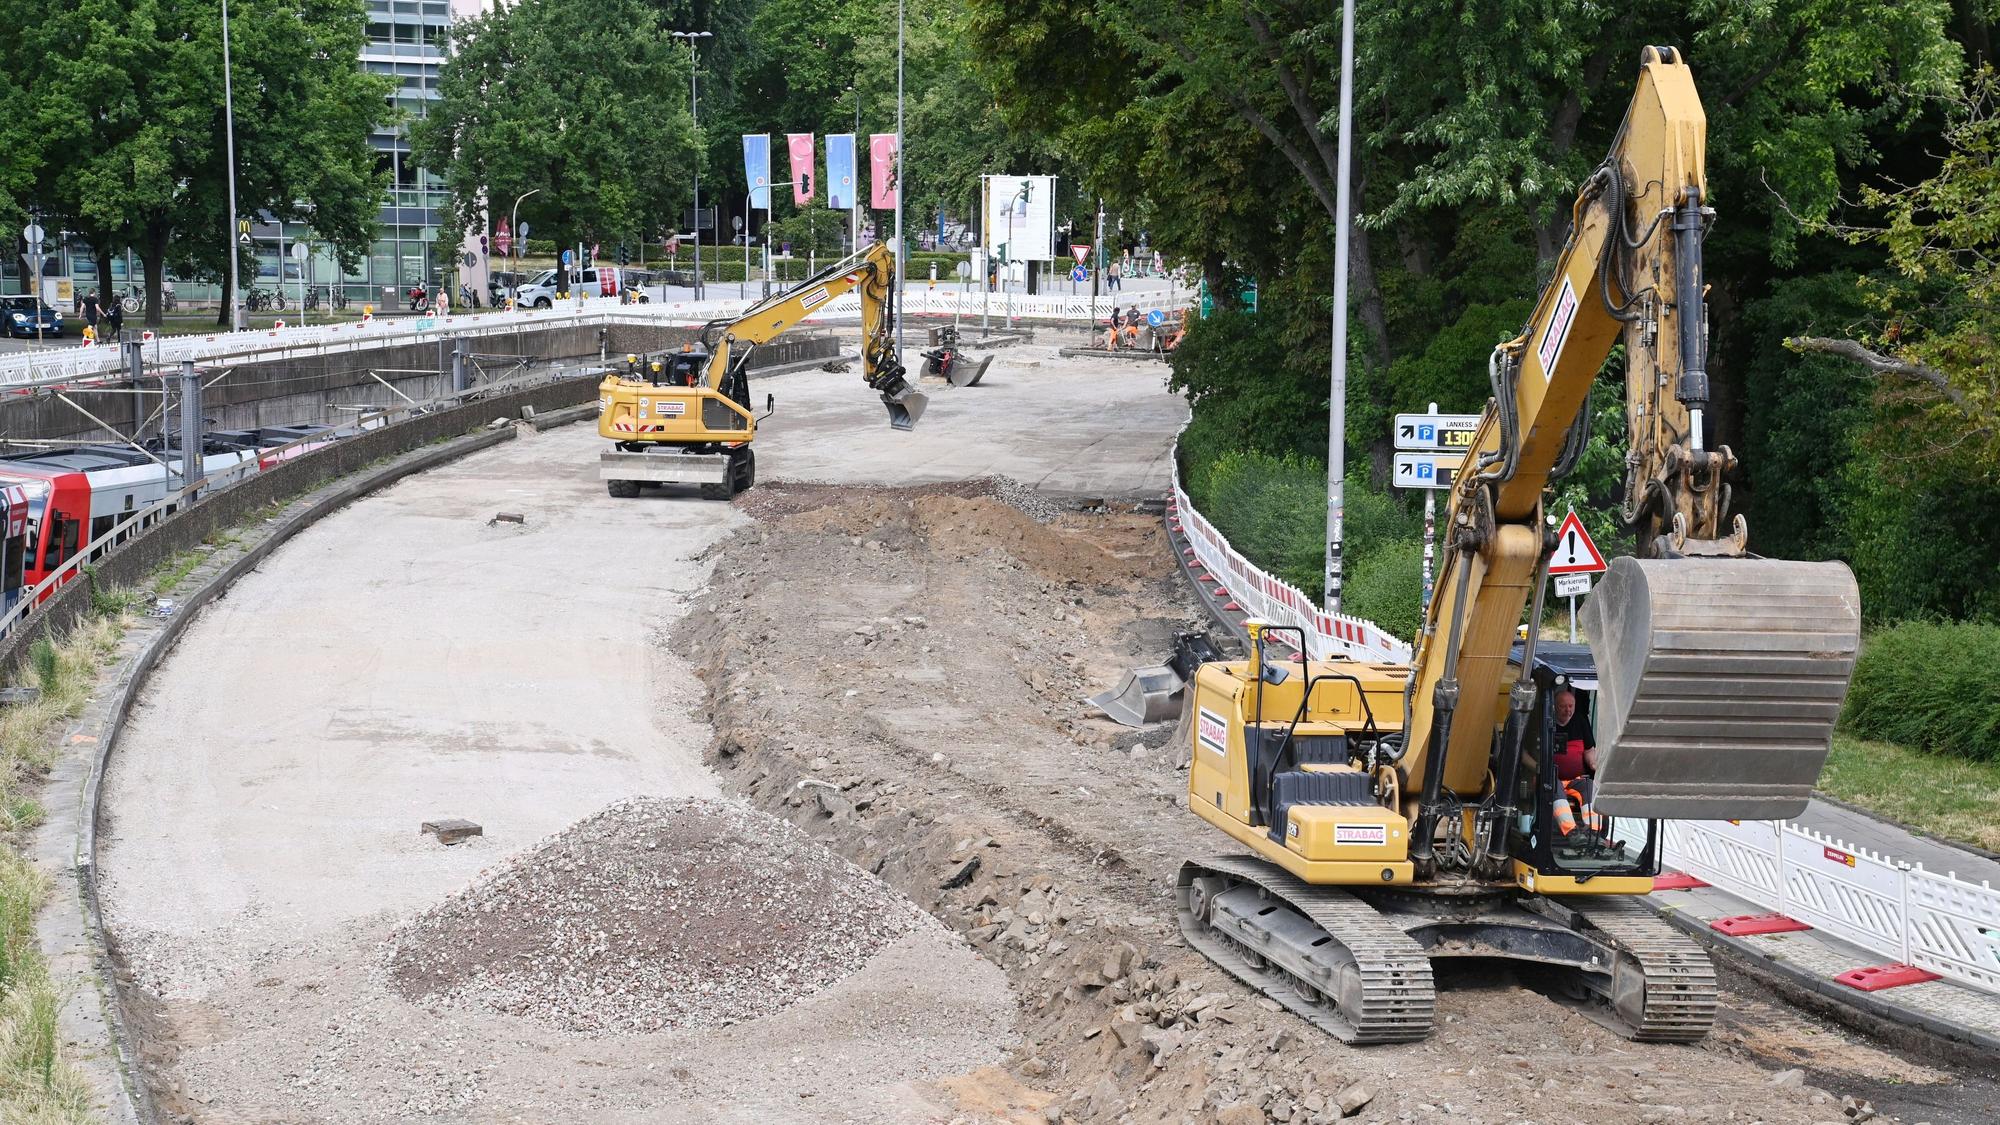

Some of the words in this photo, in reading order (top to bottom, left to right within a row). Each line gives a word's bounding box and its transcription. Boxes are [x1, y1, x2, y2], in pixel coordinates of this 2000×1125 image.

[803, 291, 827, 305] STRABAG
[1542, 290, 1573, 368] STRABAG
[1200, 718, 1225, 745] STRABAG
[1336, 830, 1384, 840] STRABAG
[1827, 850, 1845, 861] ZEPPELIN
